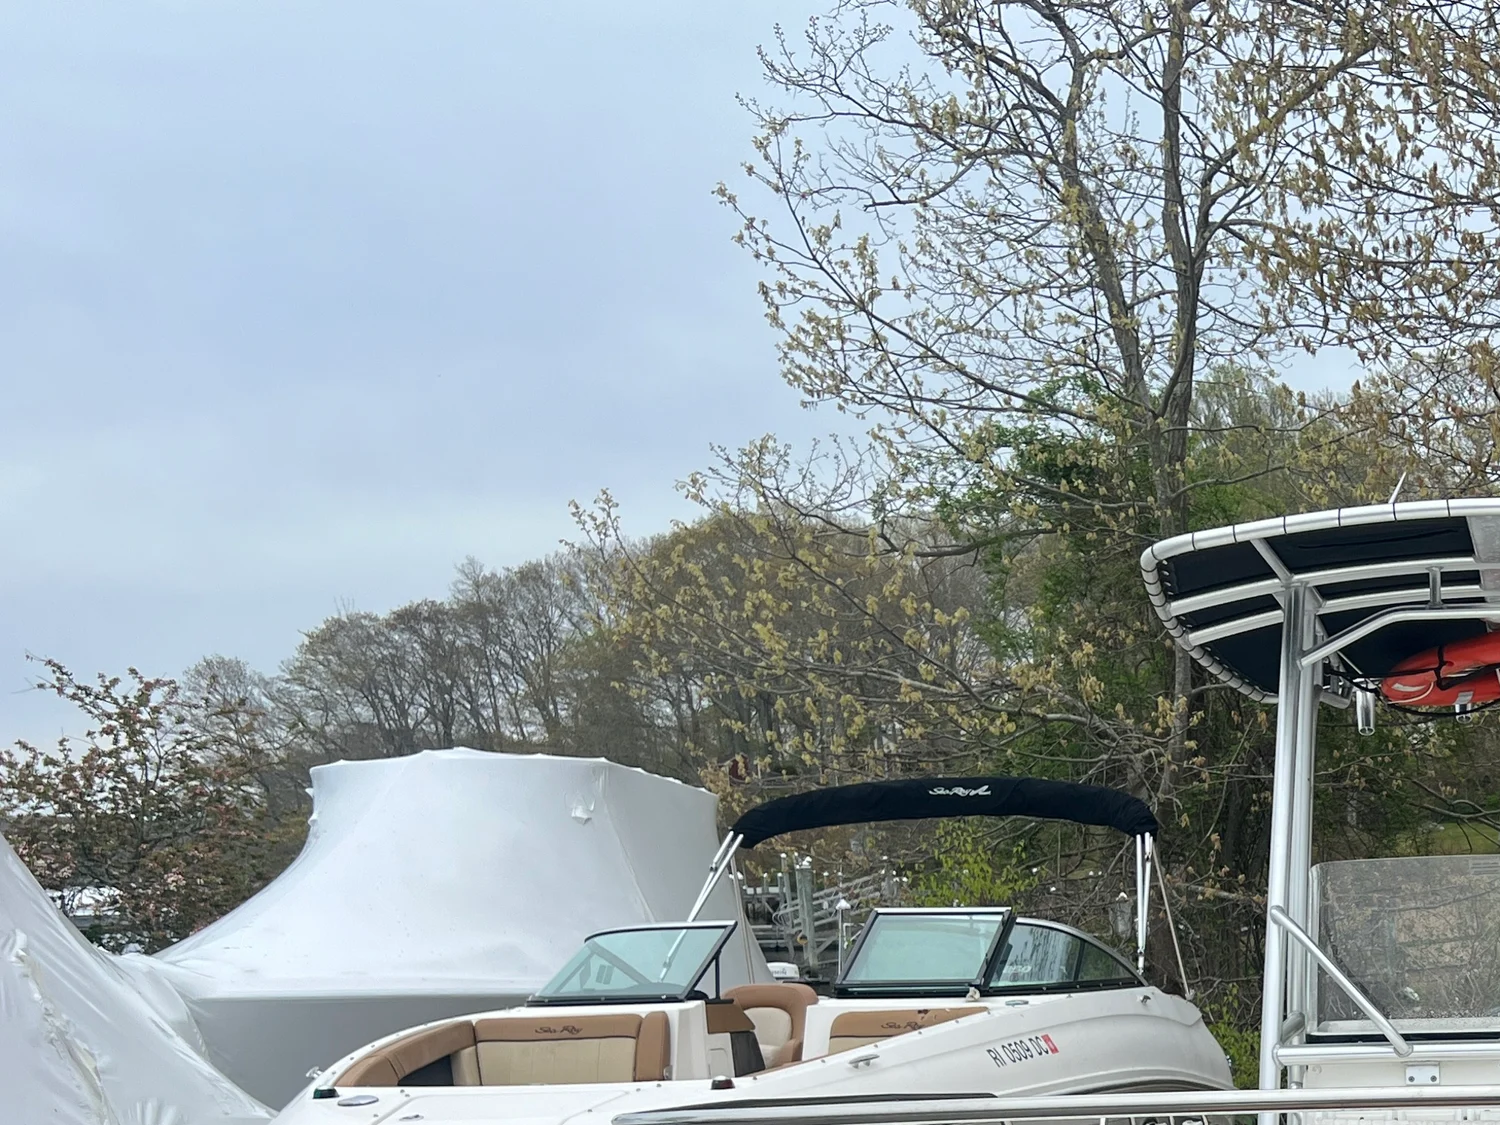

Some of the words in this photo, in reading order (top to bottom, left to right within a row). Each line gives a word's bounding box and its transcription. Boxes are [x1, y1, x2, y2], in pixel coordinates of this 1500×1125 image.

[986, 1047, 1007, 1068] RI
[1001, 1040, 1034, 1063] 0509
[1028, 1035, 1049, 1056] DC
